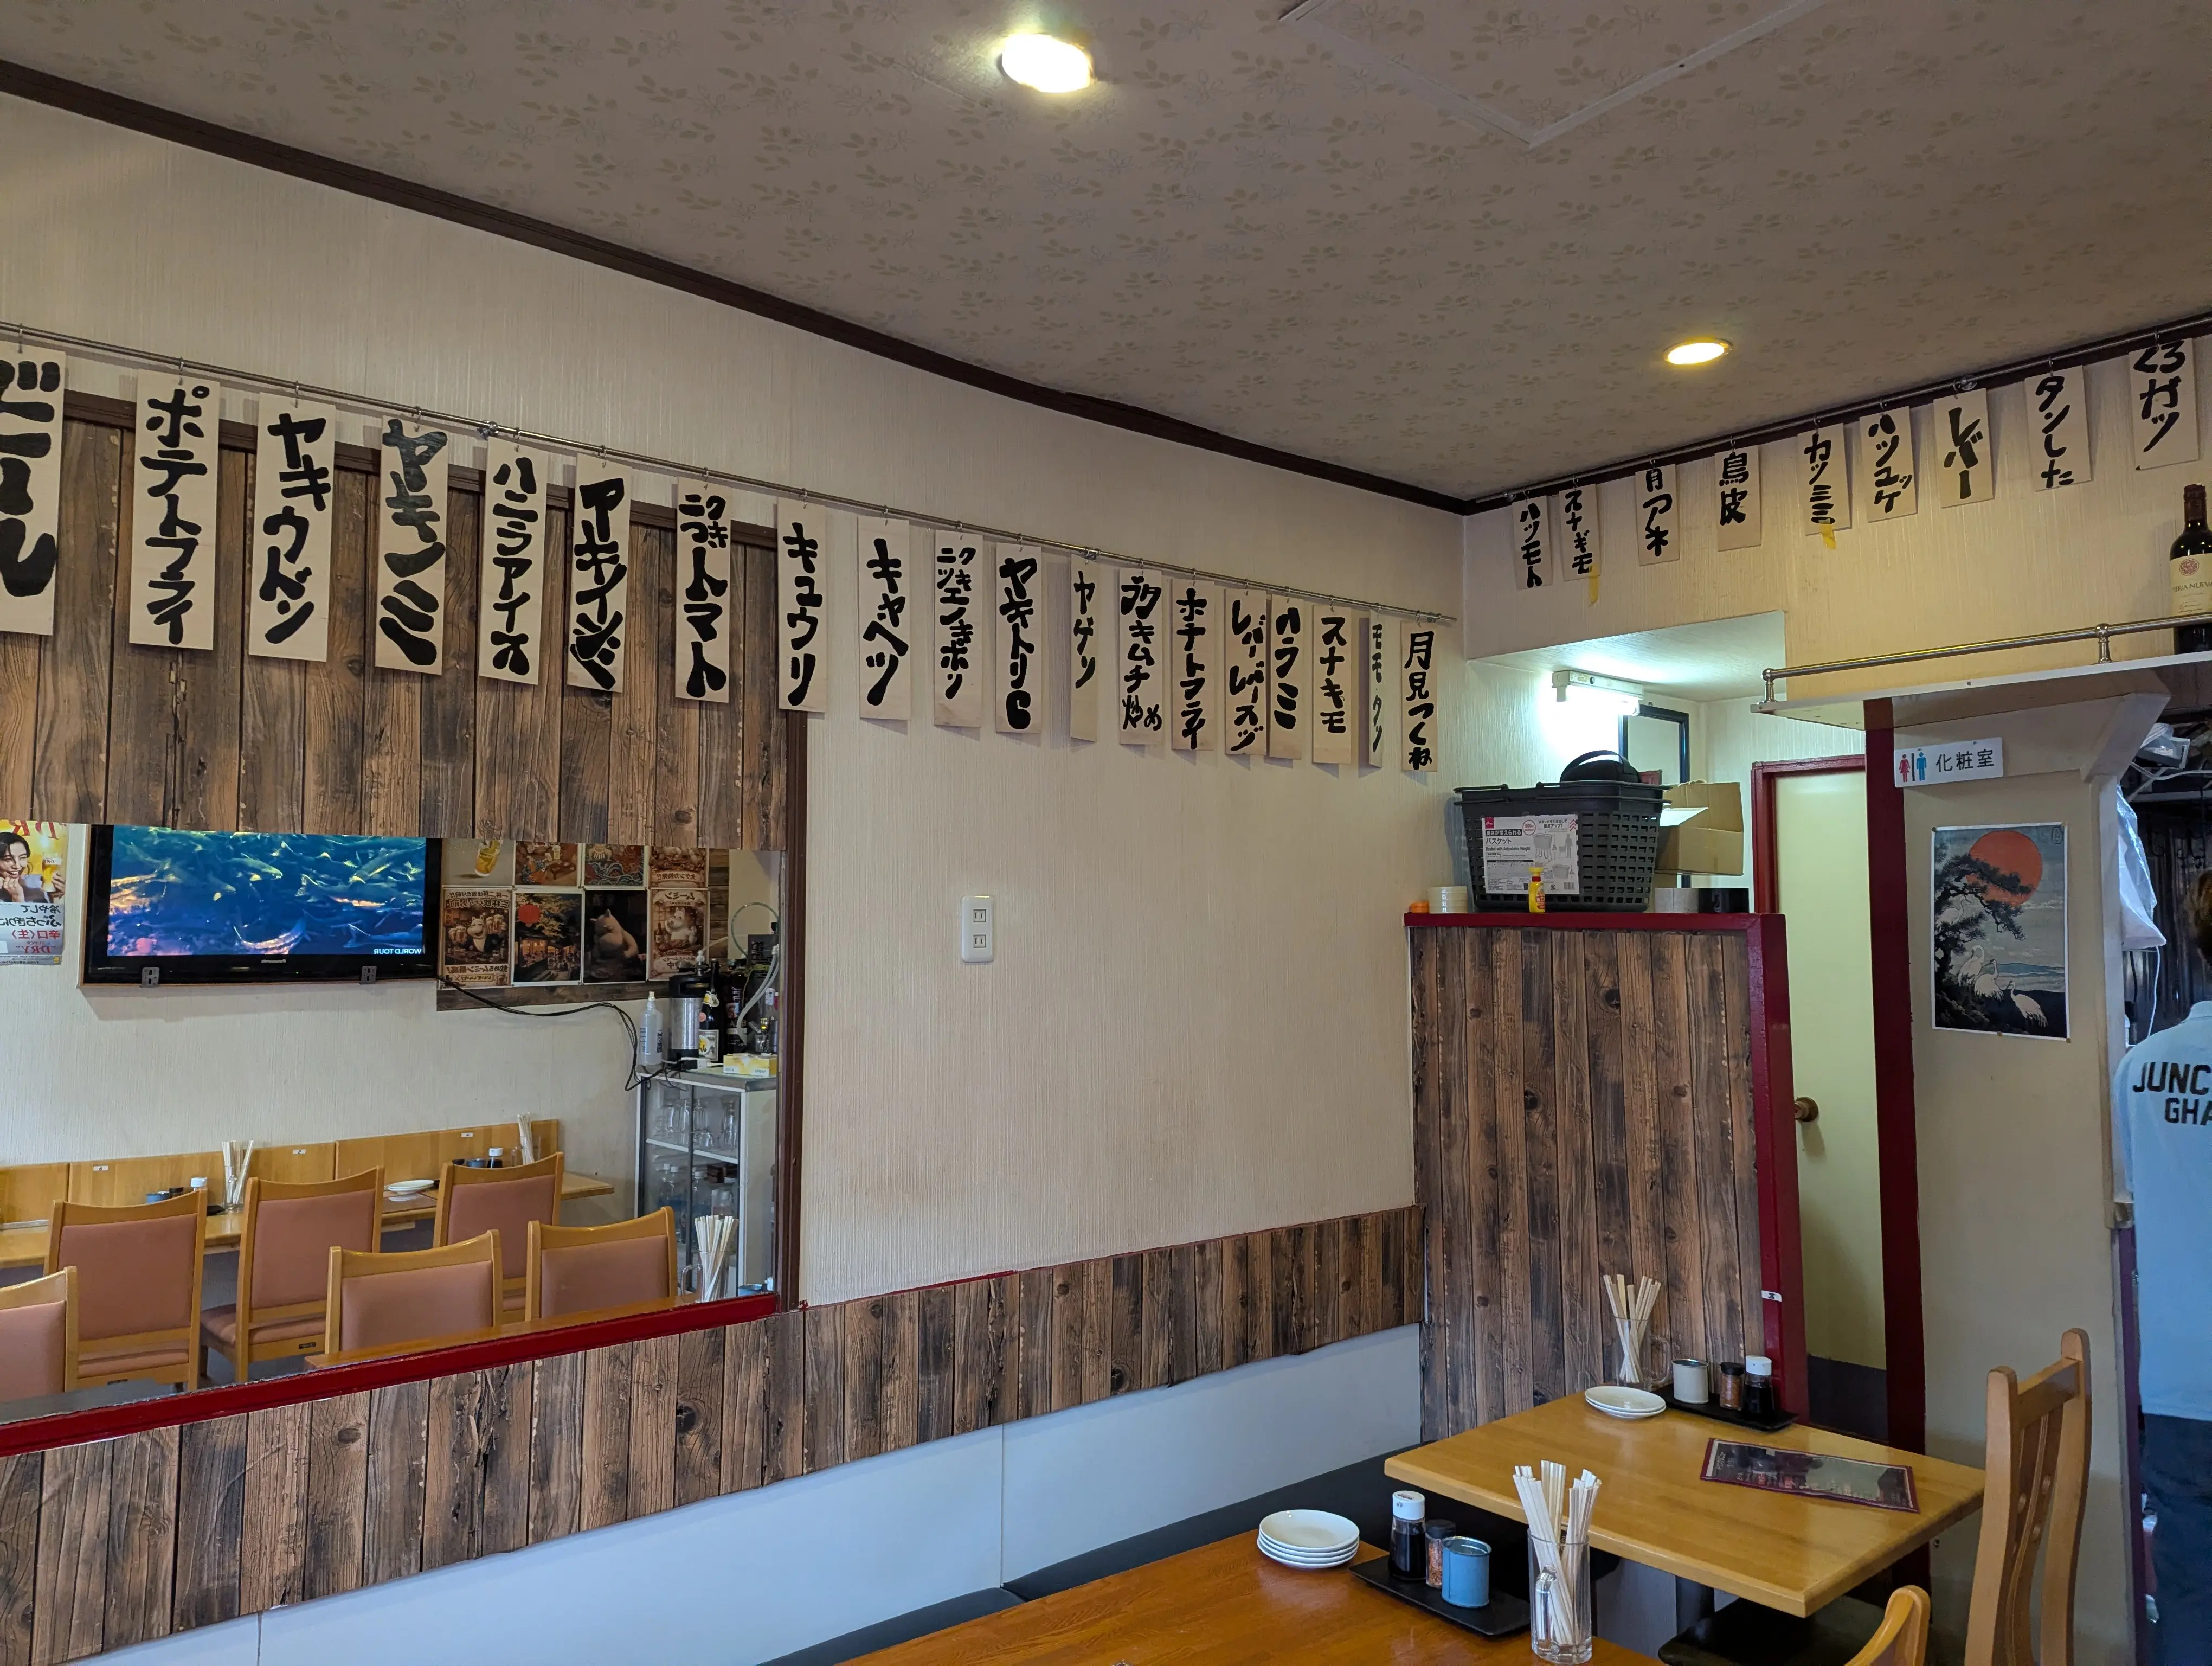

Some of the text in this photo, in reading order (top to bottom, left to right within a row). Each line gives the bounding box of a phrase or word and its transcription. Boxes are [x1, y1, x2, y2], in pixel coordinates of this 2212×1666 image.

[1719, 452, 1750, 526] 鳥皮
[1944, 407, 1984, 499] レバー
[140, 386, 210, 645] ポテトフライ
[259, 413, 331, 644] ヤキウドン
[1520, 503, 1543, 588] ハツモト
[783, 522, 823, 706] キュウリ
[1274, 607, 1301, 730] ハラミ
[1404, 631, 1435, 771] 月見つくね
[1935, 748, 1995, 773] 化粧室
[2132, 1061, 2211, 1095] JUNC
